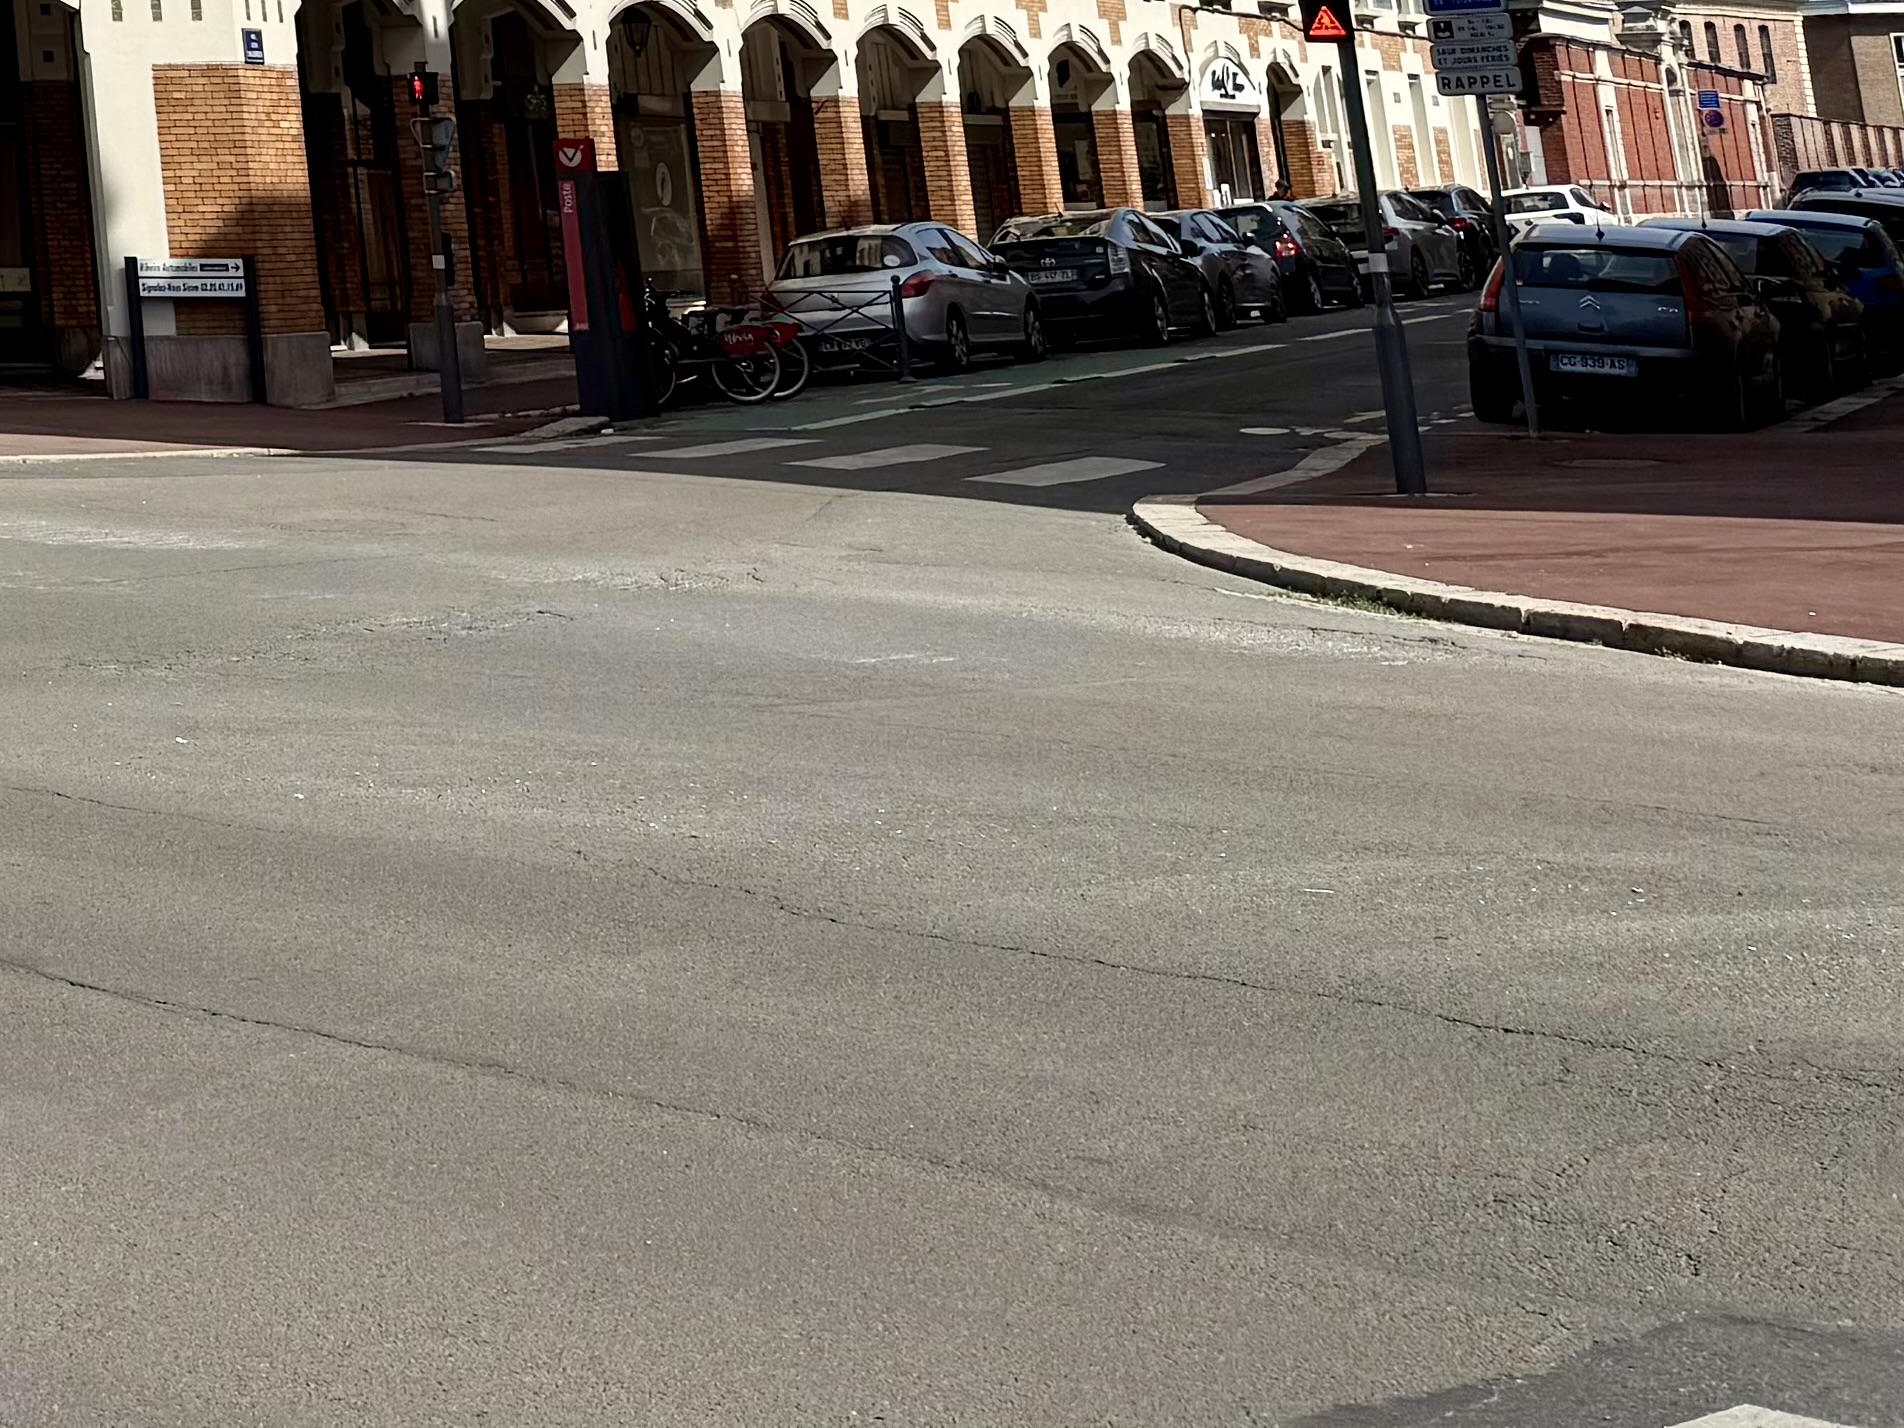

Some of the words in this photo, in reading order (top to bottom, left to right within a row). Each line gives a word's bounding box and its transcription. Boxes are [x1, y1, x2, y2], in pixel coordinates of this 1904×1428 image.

[1459, 45, 1509, 56] DIMANCHES
[1451, 56, 1477, 65] JOURS
[1442, 73, 1516, 90] RAPPEL
